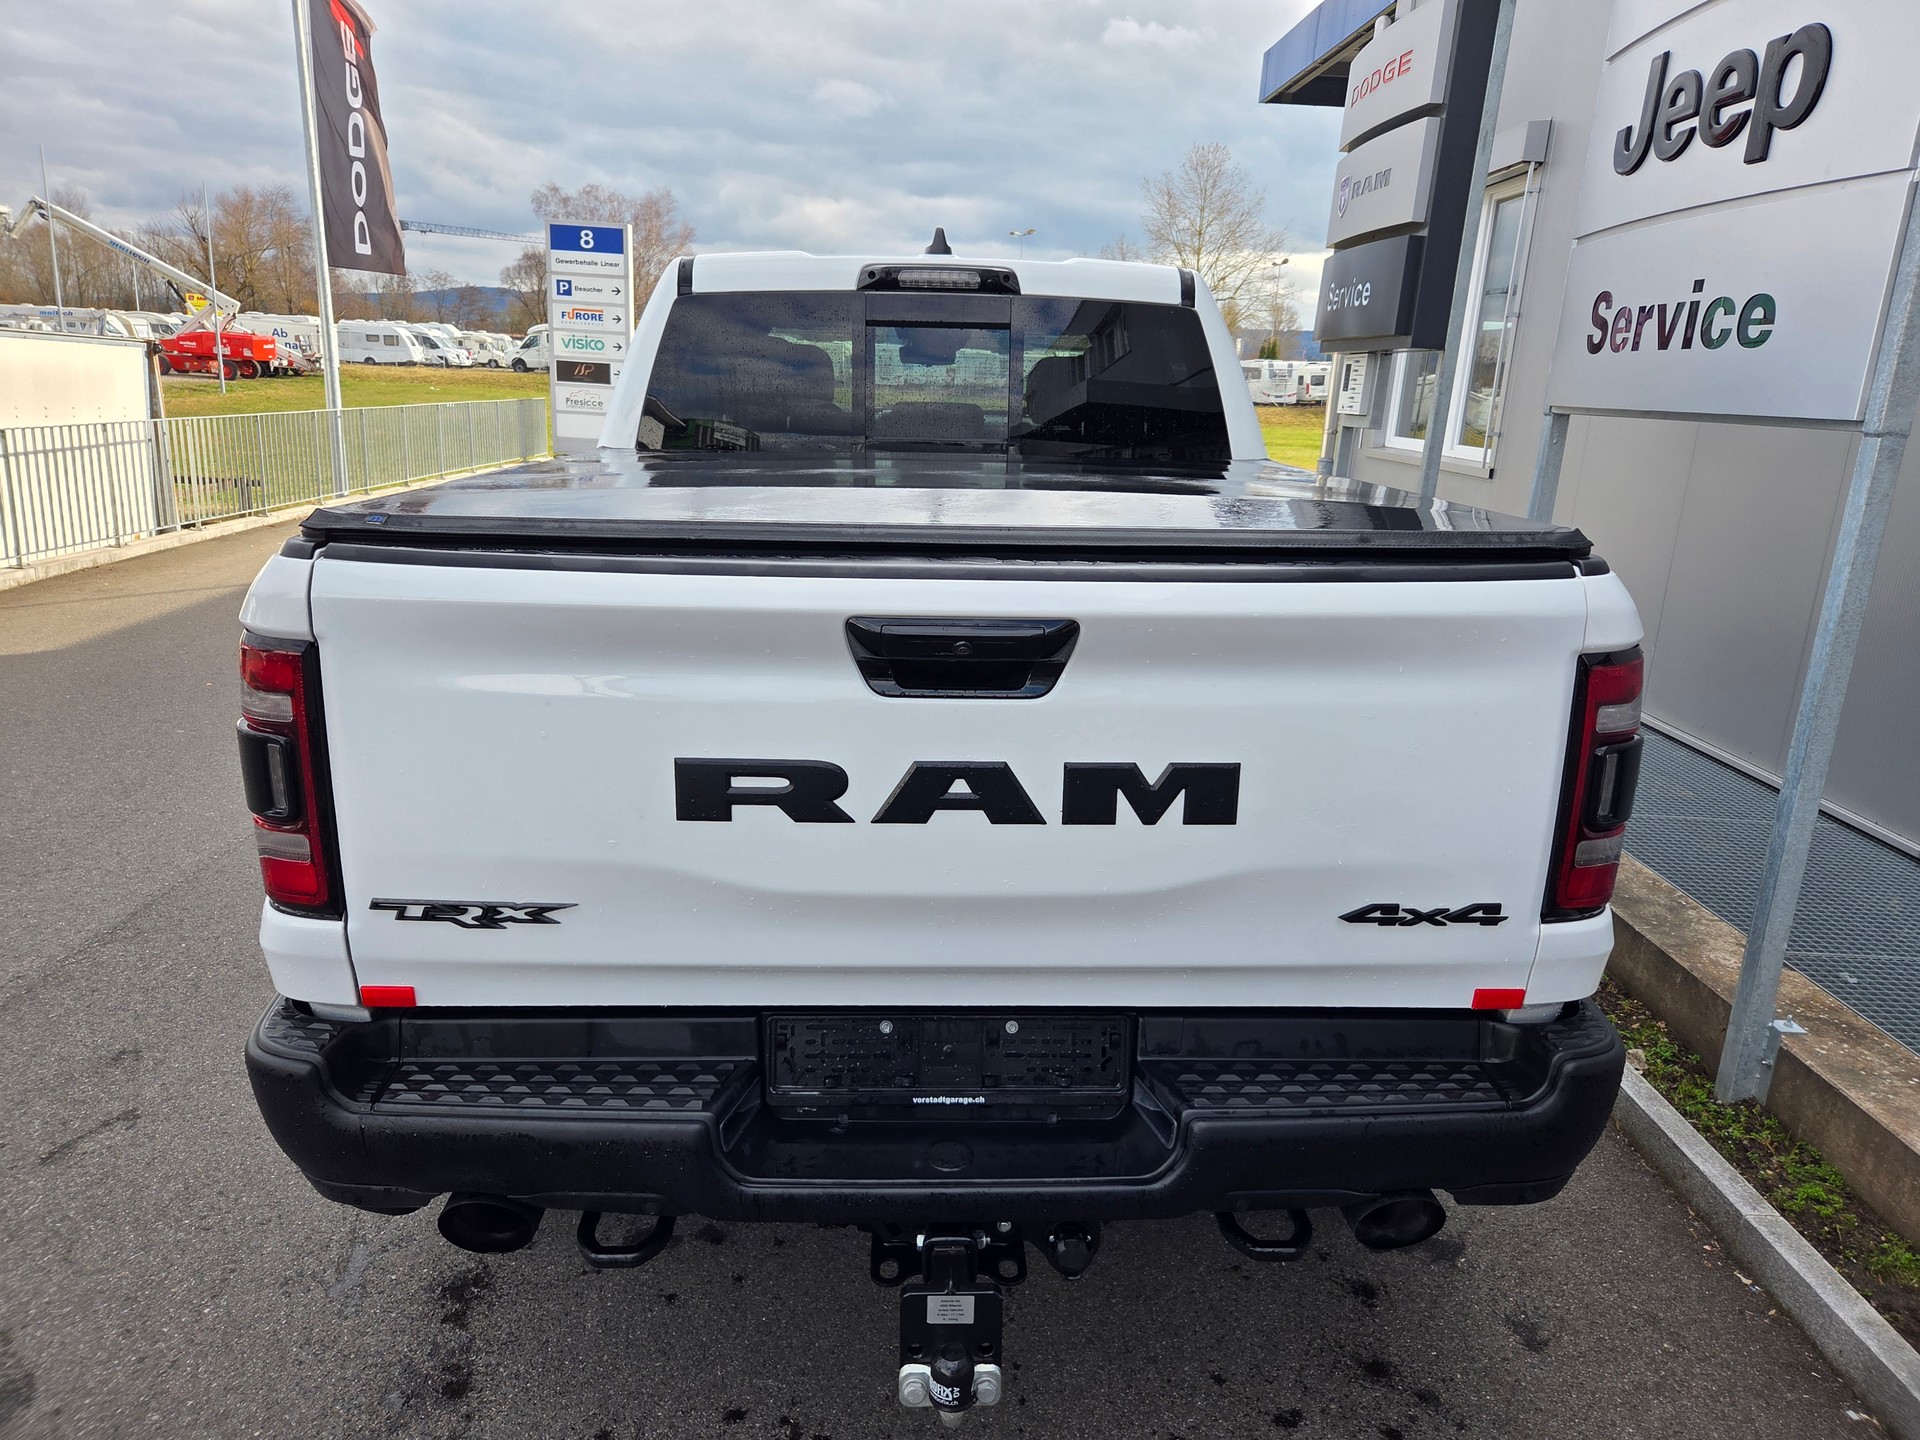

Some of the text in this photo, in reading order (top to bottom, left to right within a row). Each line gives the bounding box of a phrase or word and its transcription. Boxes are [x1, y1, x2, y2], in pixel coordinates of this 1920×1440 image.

[1351, 49, 1414, 108] DODGE
[1613, 22, 1832, 177] Jeep
[340, 20, 371, 255] DODGE
[1351, 167, 1392, 200] RAM
[580, 229, 594, 249] 8
[555, 257, 620, 268] Gewerbehalle Linear
[559, 281, 603, 294] P Besucher
[1327, 277, 1371, 312] Service
[561, 309, 604, 322] FURORE
[1586, 278, 1777, 355] Service
[272, 327, 288, 338] Ab
[561, 334, 605, 351] visico
[565, 397, 604, 407] Presicce
[674, 757, 1242, 826] RAM
[368, 897, 579, 930] TRX
[1337, 902, 1509, 927] 4x4
[912, 1096, 985, 1105] vorstadtgarage.ch
